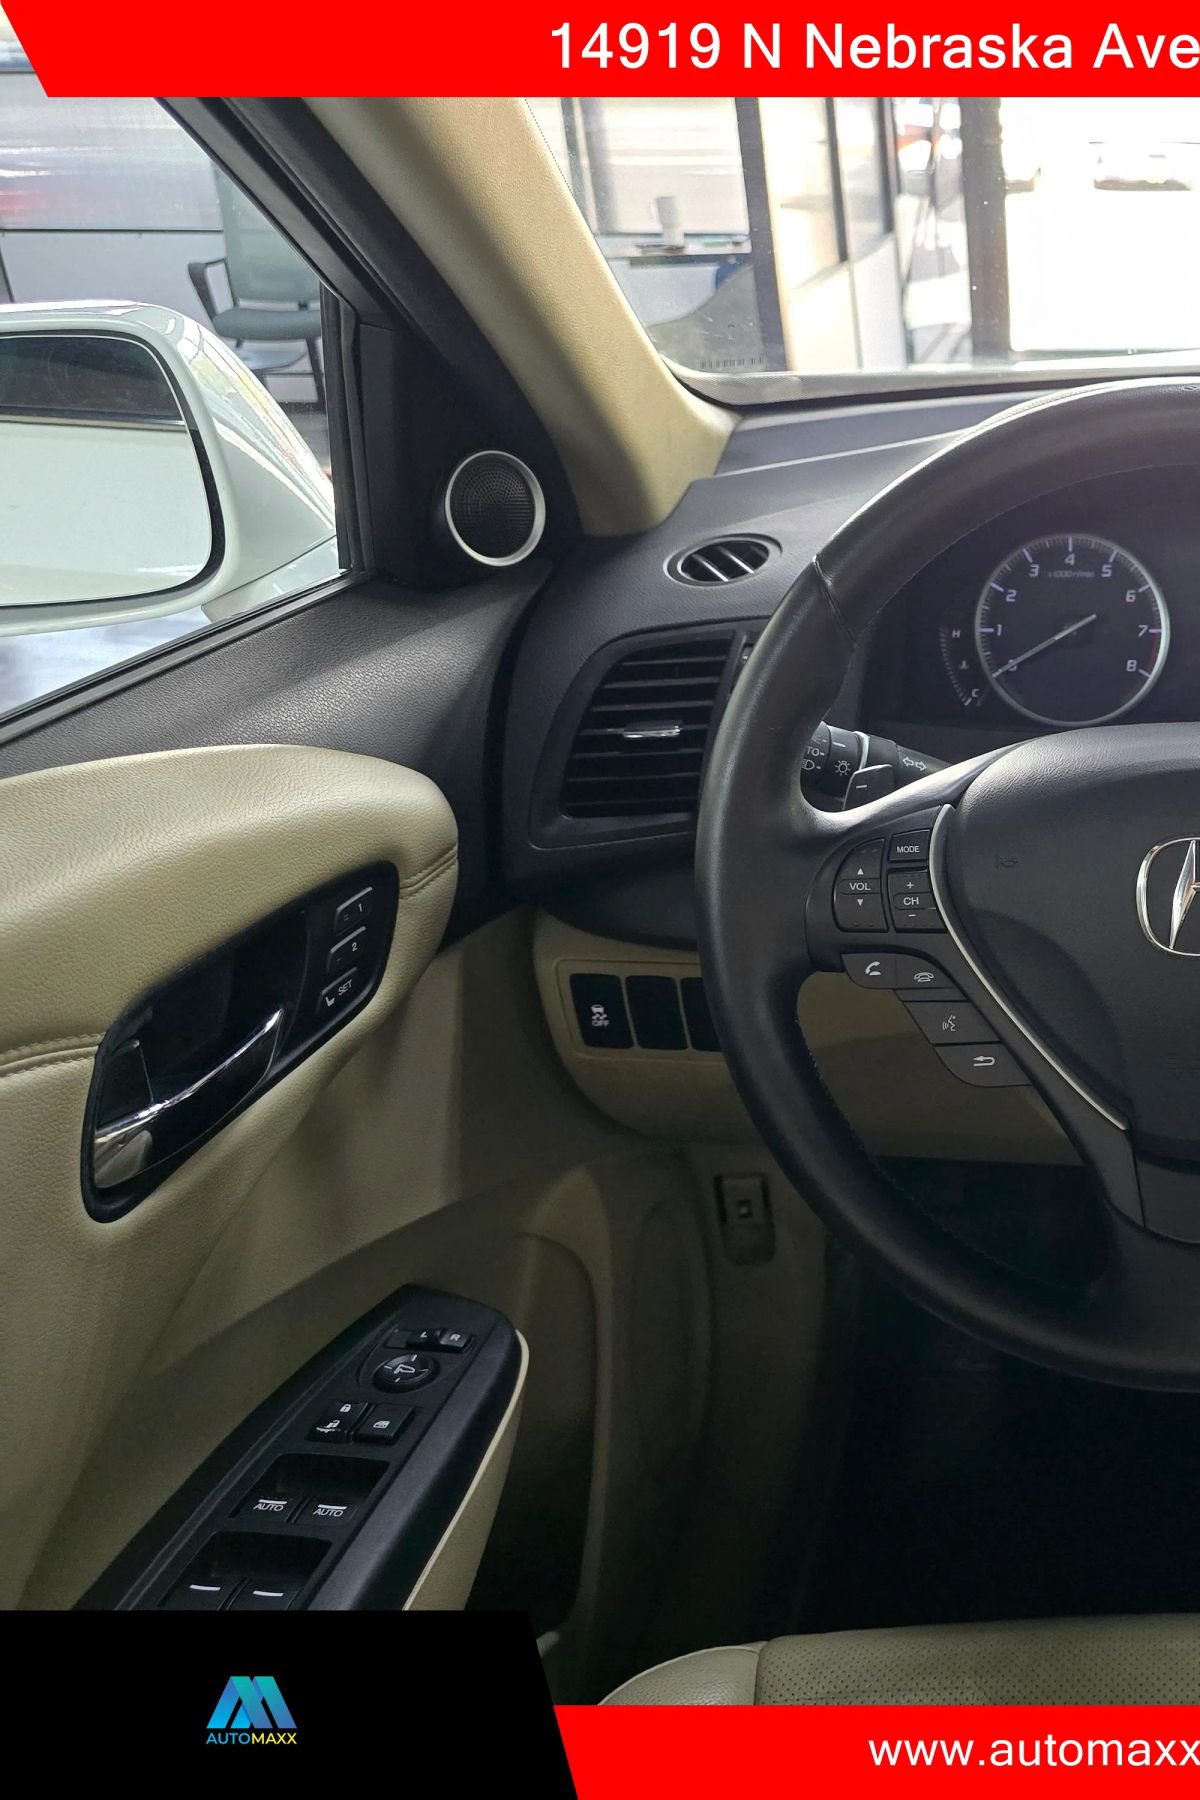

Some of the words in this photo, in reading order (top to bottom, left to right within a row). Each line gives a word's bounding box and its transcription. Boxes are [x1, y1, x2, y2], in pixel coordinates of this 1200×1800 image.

[1065, 553, 1075, 565] 4
[1029, 565, 1039, 577] 3
[1102, 565, 1112, 577] 5
[1006, 590, 1017, 602] 2
[1126, 590, 1136, 602] 6
[1138, 624, 1148, 637] 7
[1126, 659, 1137, 671] 8
[896, 845, 921, 853] MODE
[849, 882, 872, 891] VOL
[903, 896, 920, 905] CH
[351, 942, 358, 952] 2
[338, 979, 353, 996] SET
[450, 1333, 461, 1341] R
[253, 1503, 285, 1512] AUTO
[312, 1508, 344, 1517] AUTO
